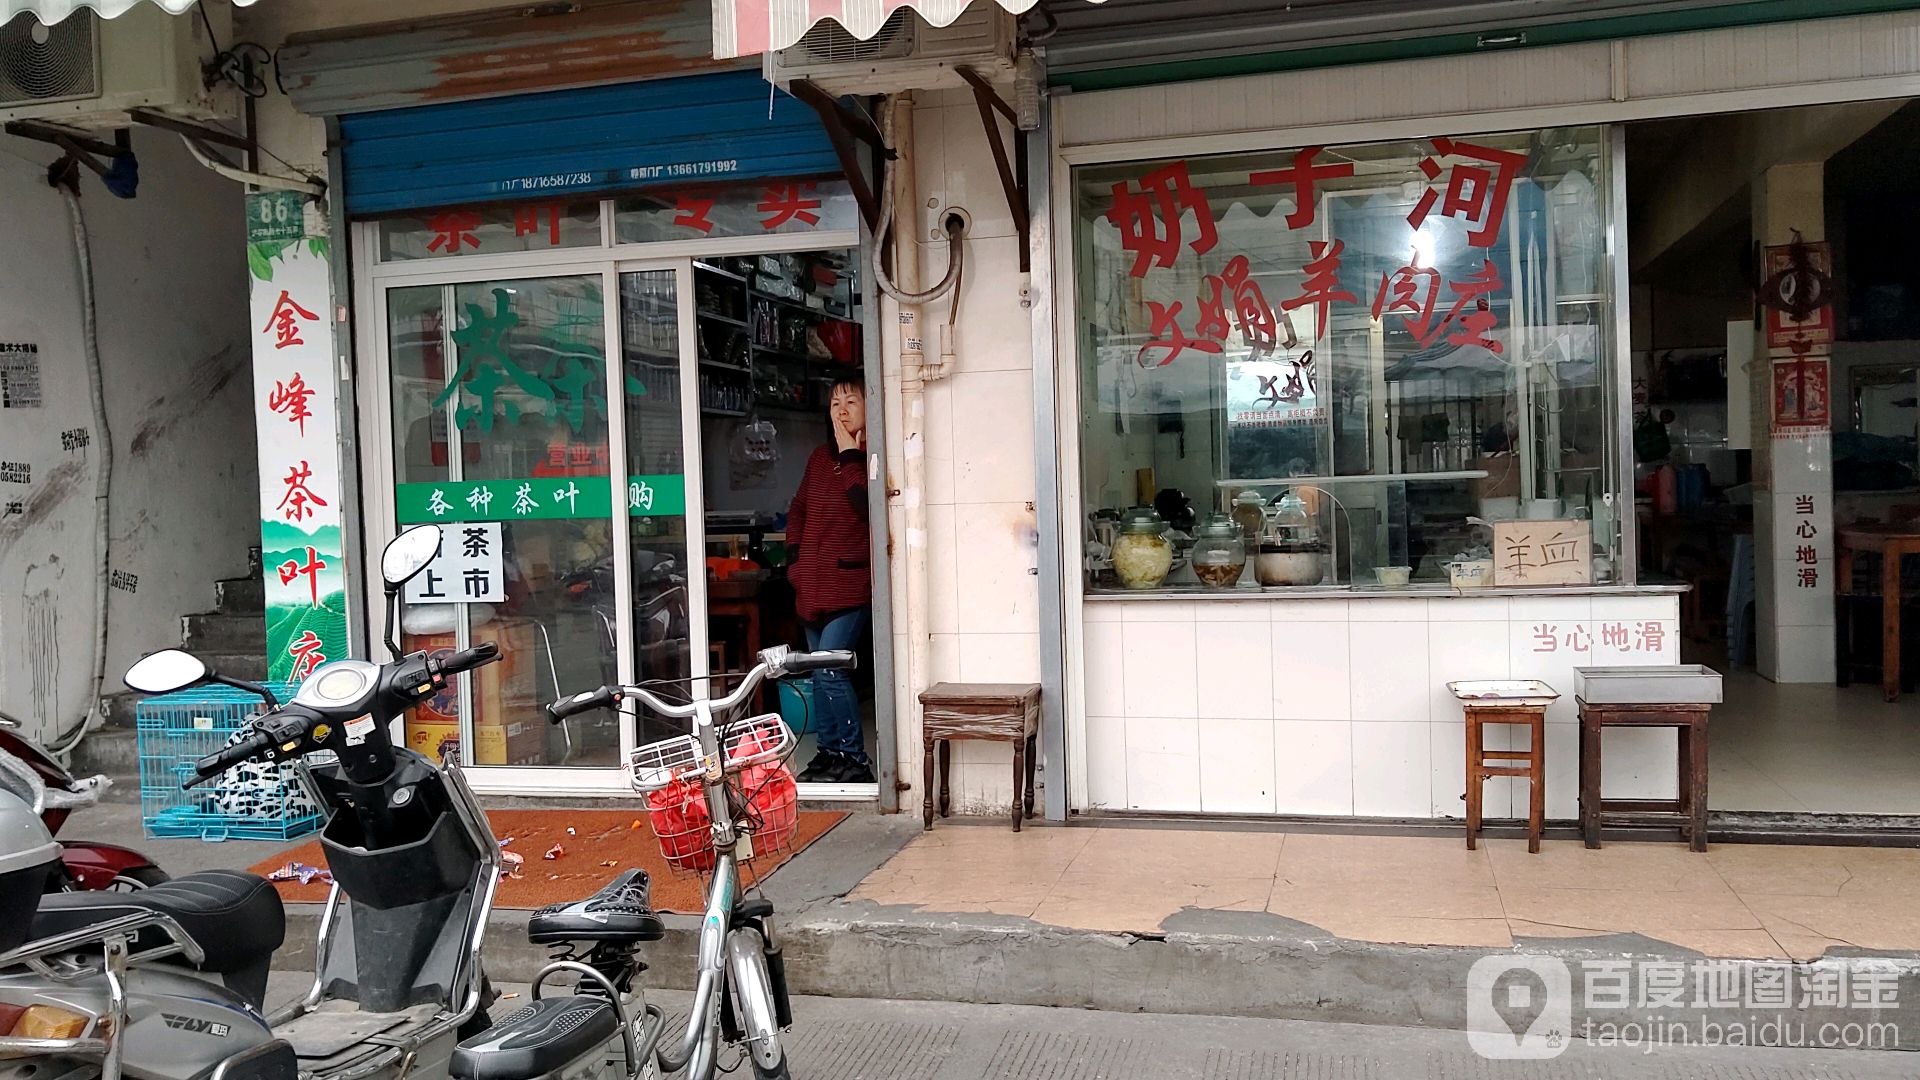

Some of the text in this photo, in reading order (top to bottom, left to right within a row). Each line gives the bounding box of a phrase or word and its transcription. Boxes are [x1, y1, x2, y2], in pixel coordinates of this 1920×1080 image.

[666, 159, 737, 176] 13661791992
[261, 198, 288, 224] 86
[1, 472, 31, 484] 0582216
[1504, 532, 1580, 578] 羊血
[1796, 494, 1818, 588] 当心地滑
[419, 568, 490, 598] 上市
[1533, 621, 1666, 653] 当心地滑
